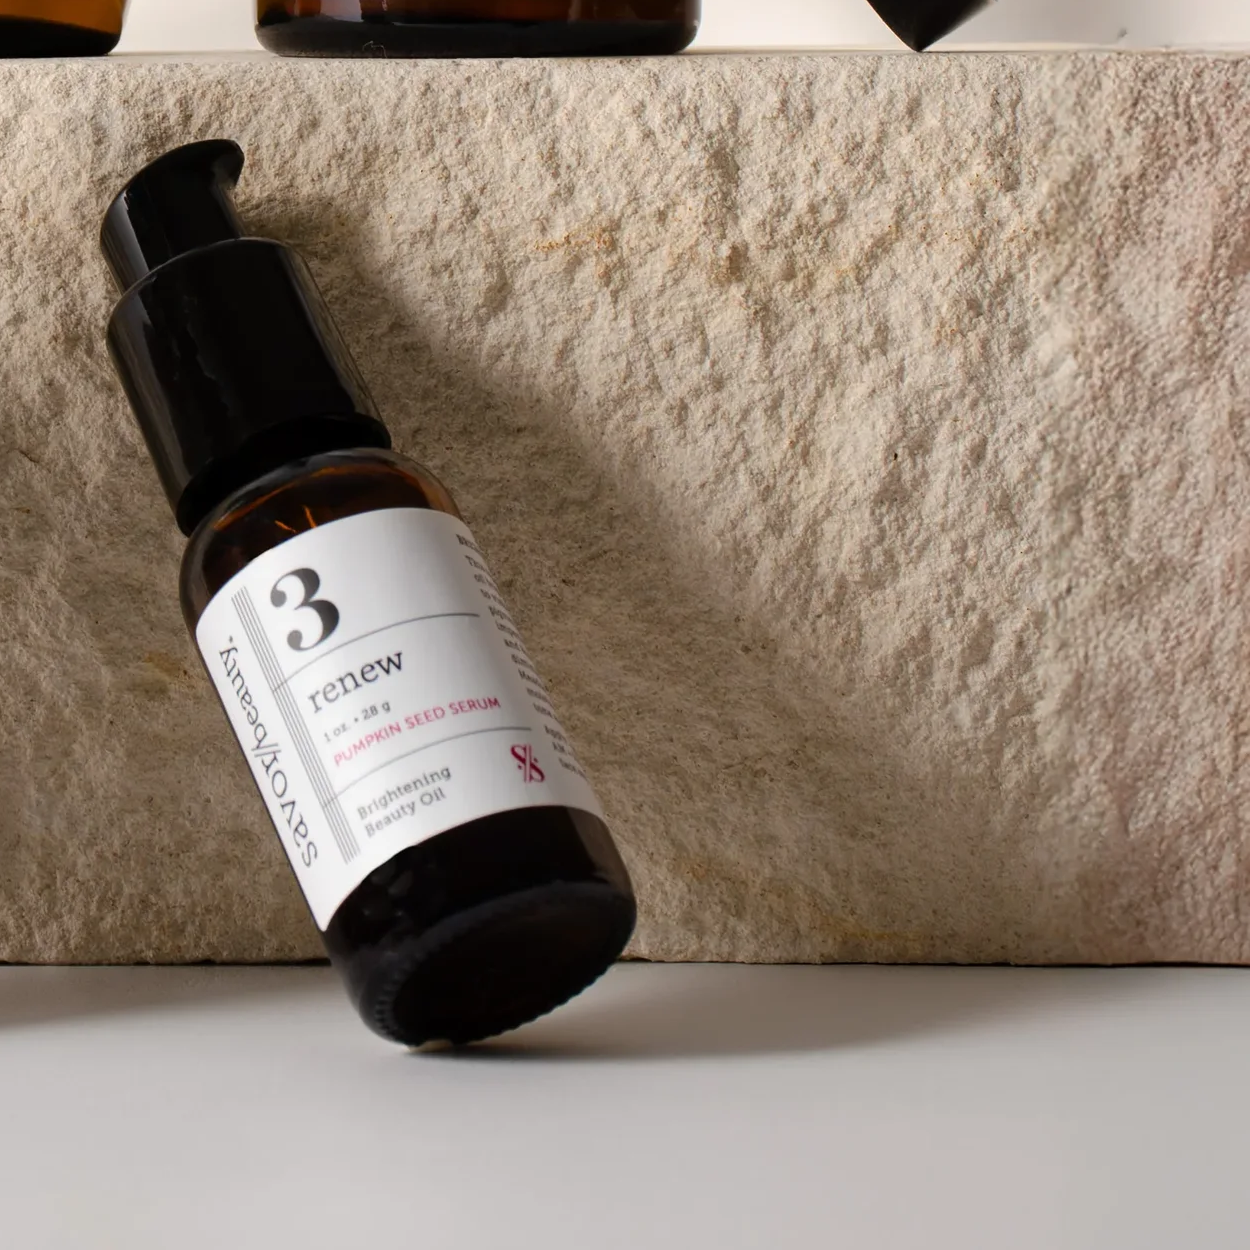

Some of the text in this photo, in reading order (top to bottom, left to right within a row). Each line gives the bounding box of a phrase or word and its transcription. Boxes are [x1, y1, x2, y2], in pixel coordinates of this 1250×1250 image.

[270, 568, 340, 651] 3
[308, 651, 404, 713] renew
[324, 732, 330, 742] 1
[362, 707, 378, 722] 28
[380, 701, 390, 717] g
[334, 696, 500, 766] PUMPKIN SEED SERUM
[358, 766, 450, 820] Brightening
[365, 789, 446, 838] Beauty Oil
